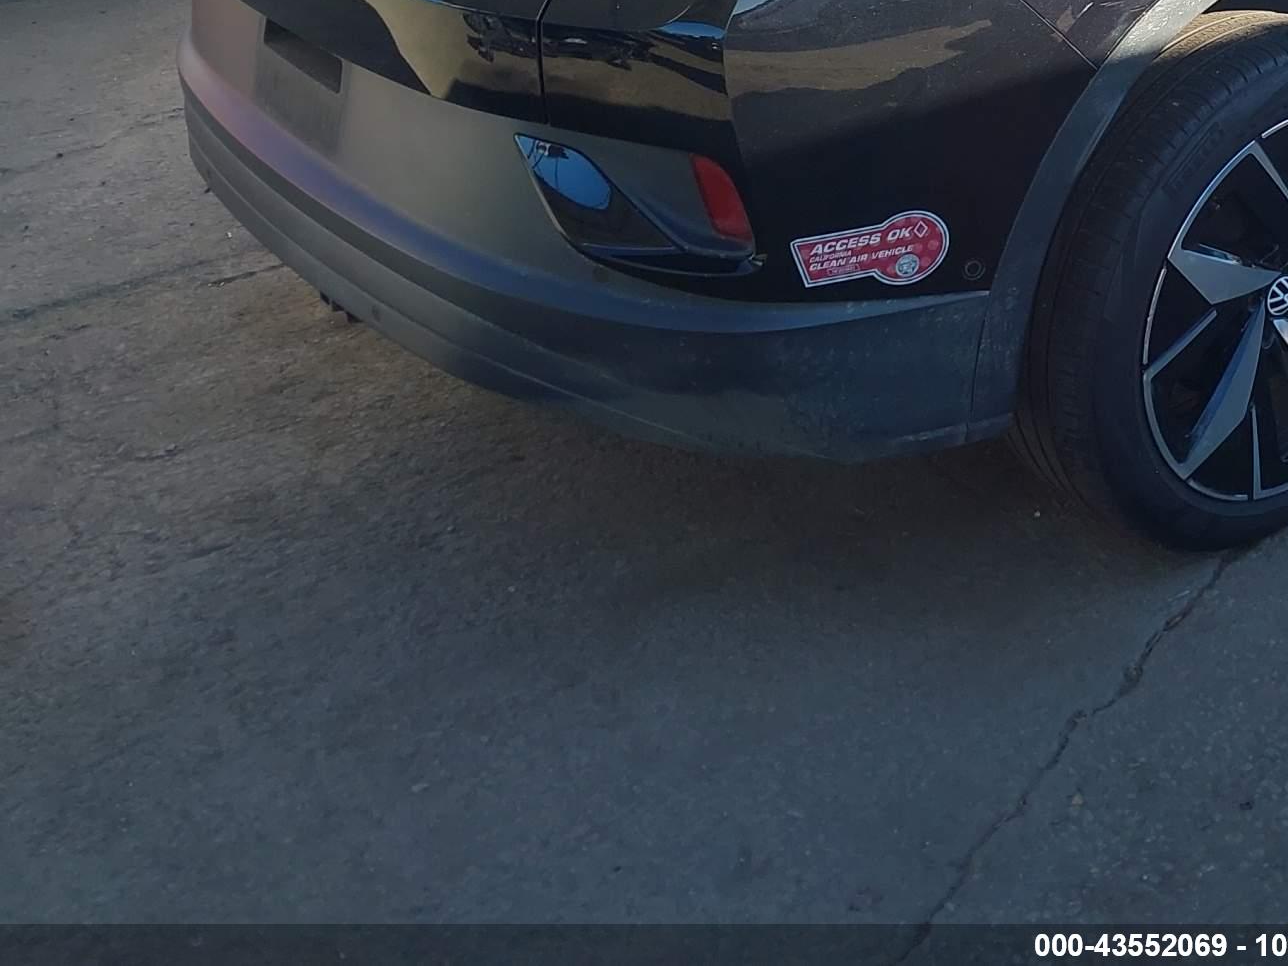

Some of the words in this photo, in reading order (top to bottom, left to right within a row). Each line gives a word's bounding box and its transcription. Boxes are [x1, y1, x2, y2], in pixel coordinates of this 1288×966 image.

[810, 233, 881, 255] ACCESS
[887, 226, 914, 241] OK
[809, 250, 852, 263] CALIFORNIA
[809, 259, 846, 271] CLEAN
[849, 253, 868, 264] AIR
[872, 245, 914, 260] VEHICLE
